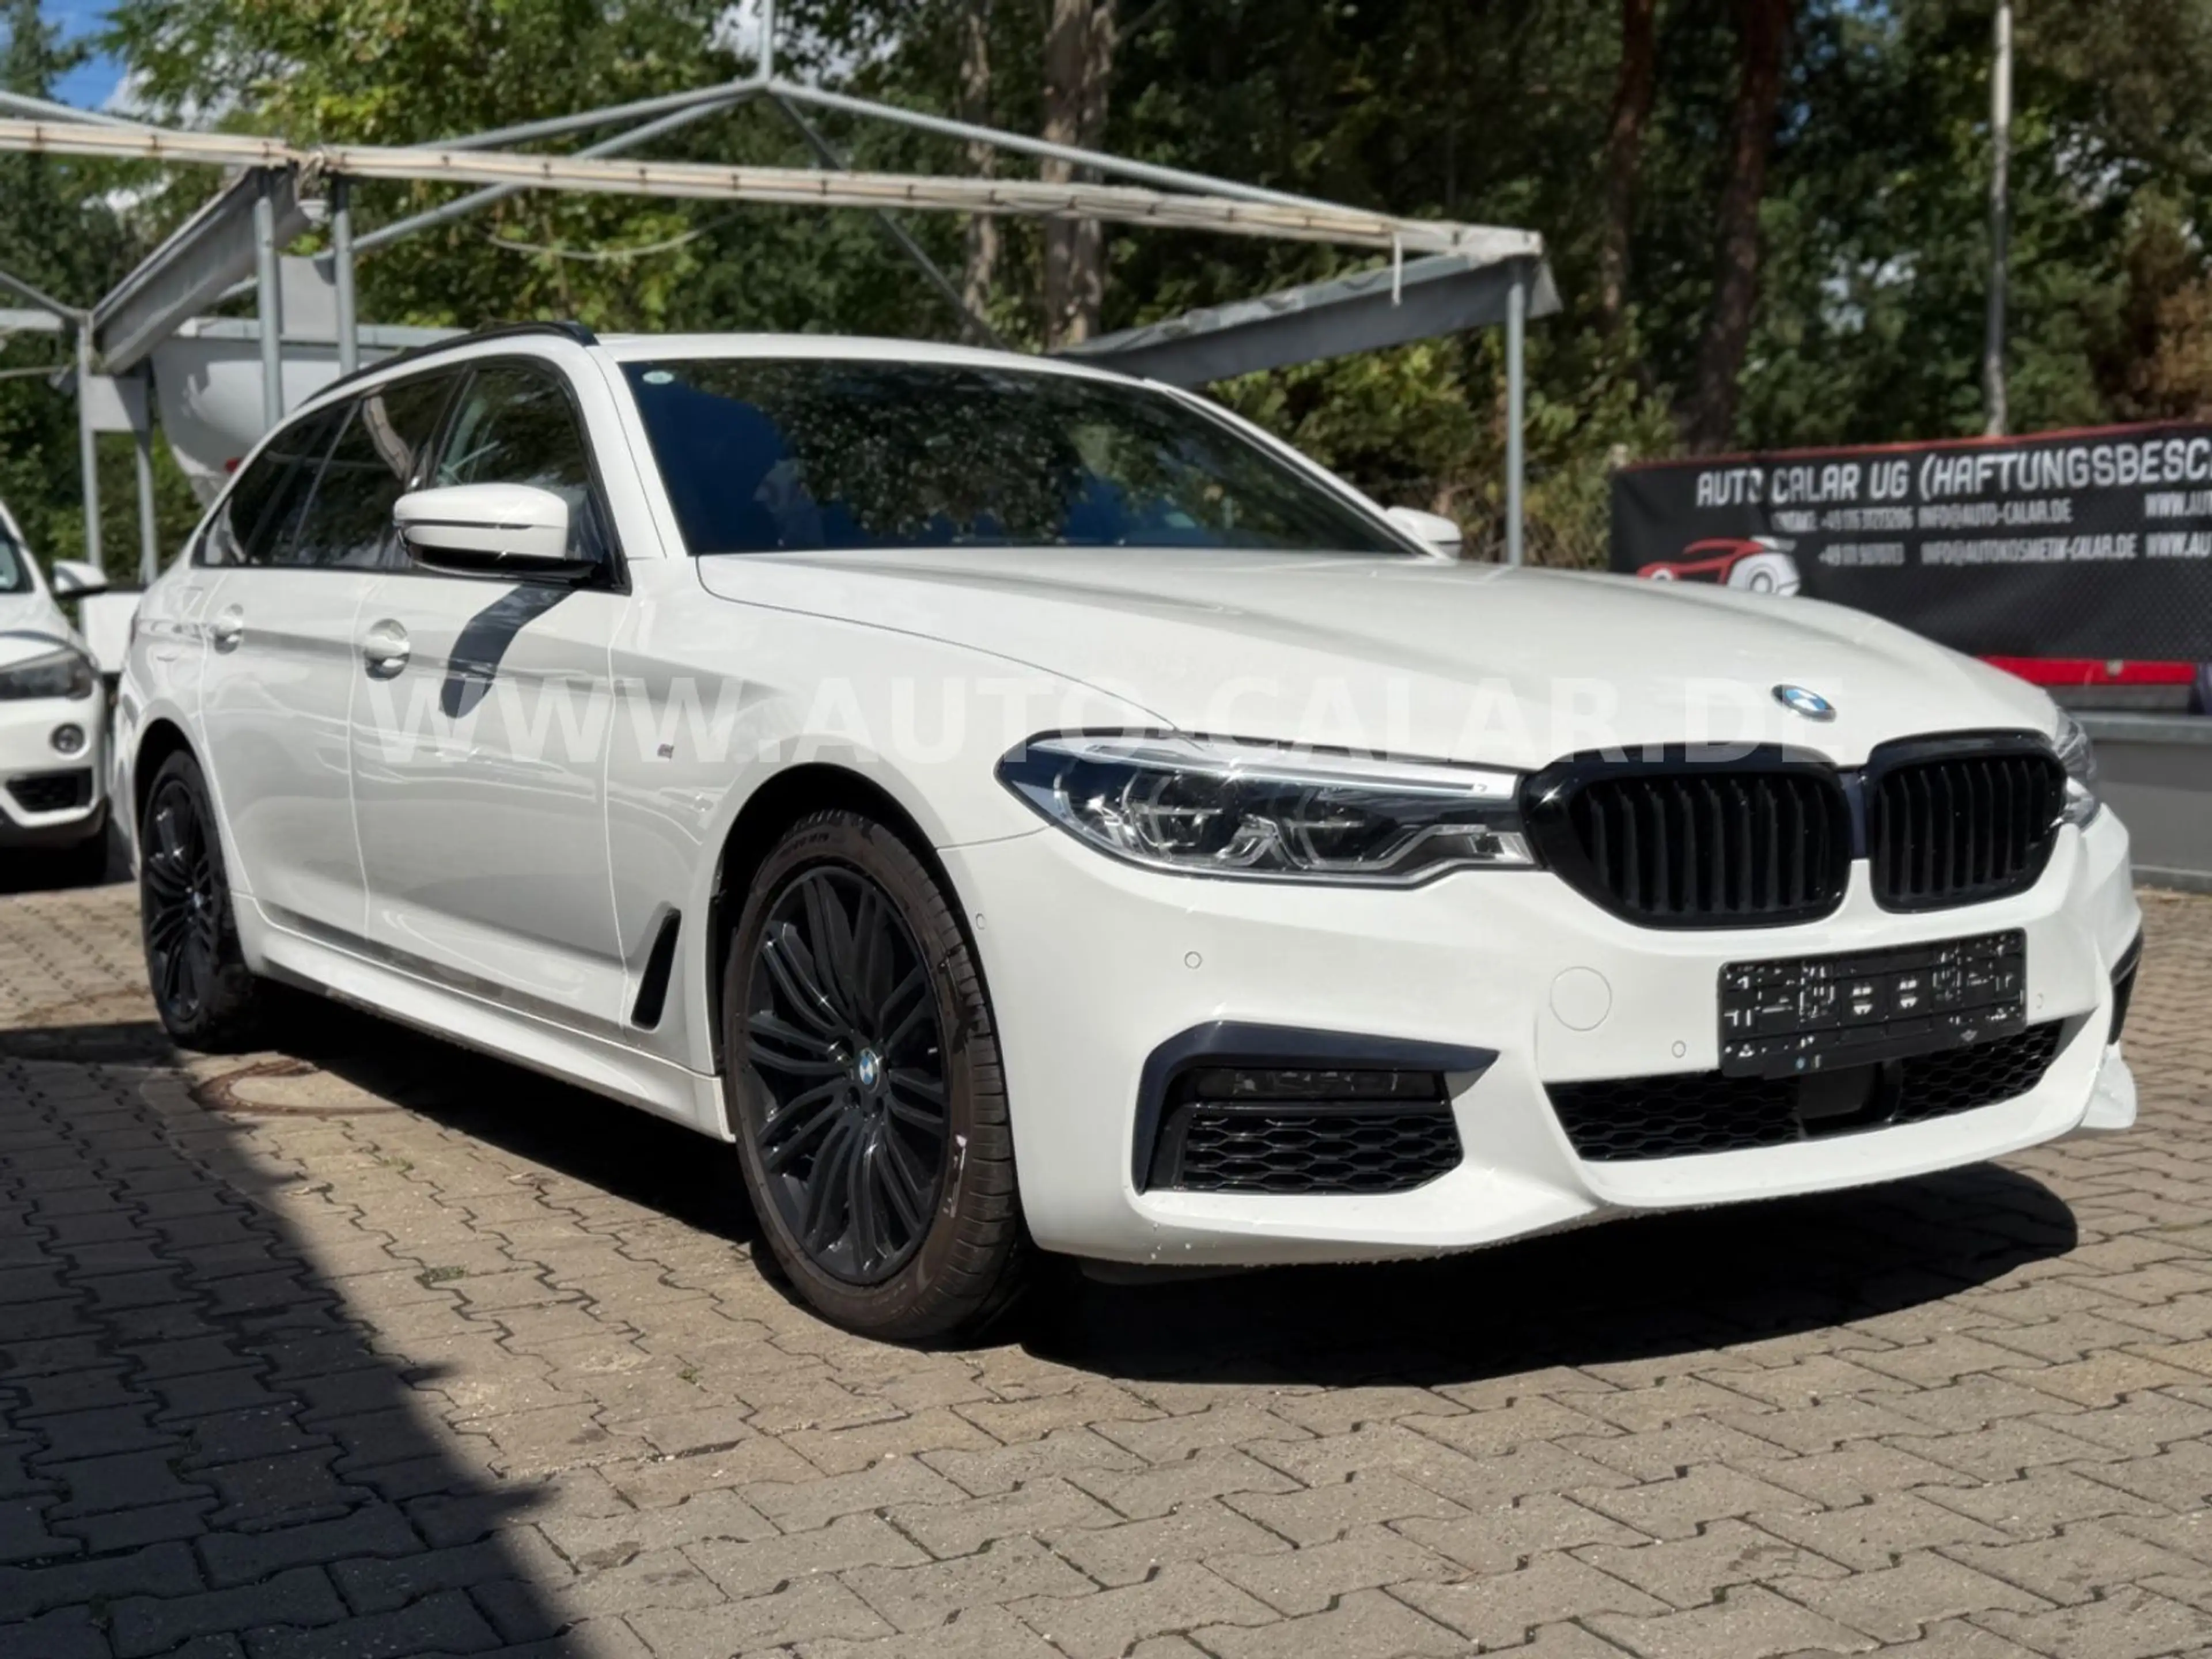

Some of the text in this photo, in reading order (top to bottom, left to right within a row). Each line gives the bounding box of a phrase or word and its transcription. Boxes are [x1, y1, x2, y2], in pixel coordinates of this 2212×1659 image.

[1696, 436, 2212, 506] AUTO CALAR UG (HAFTUNGSBESC
